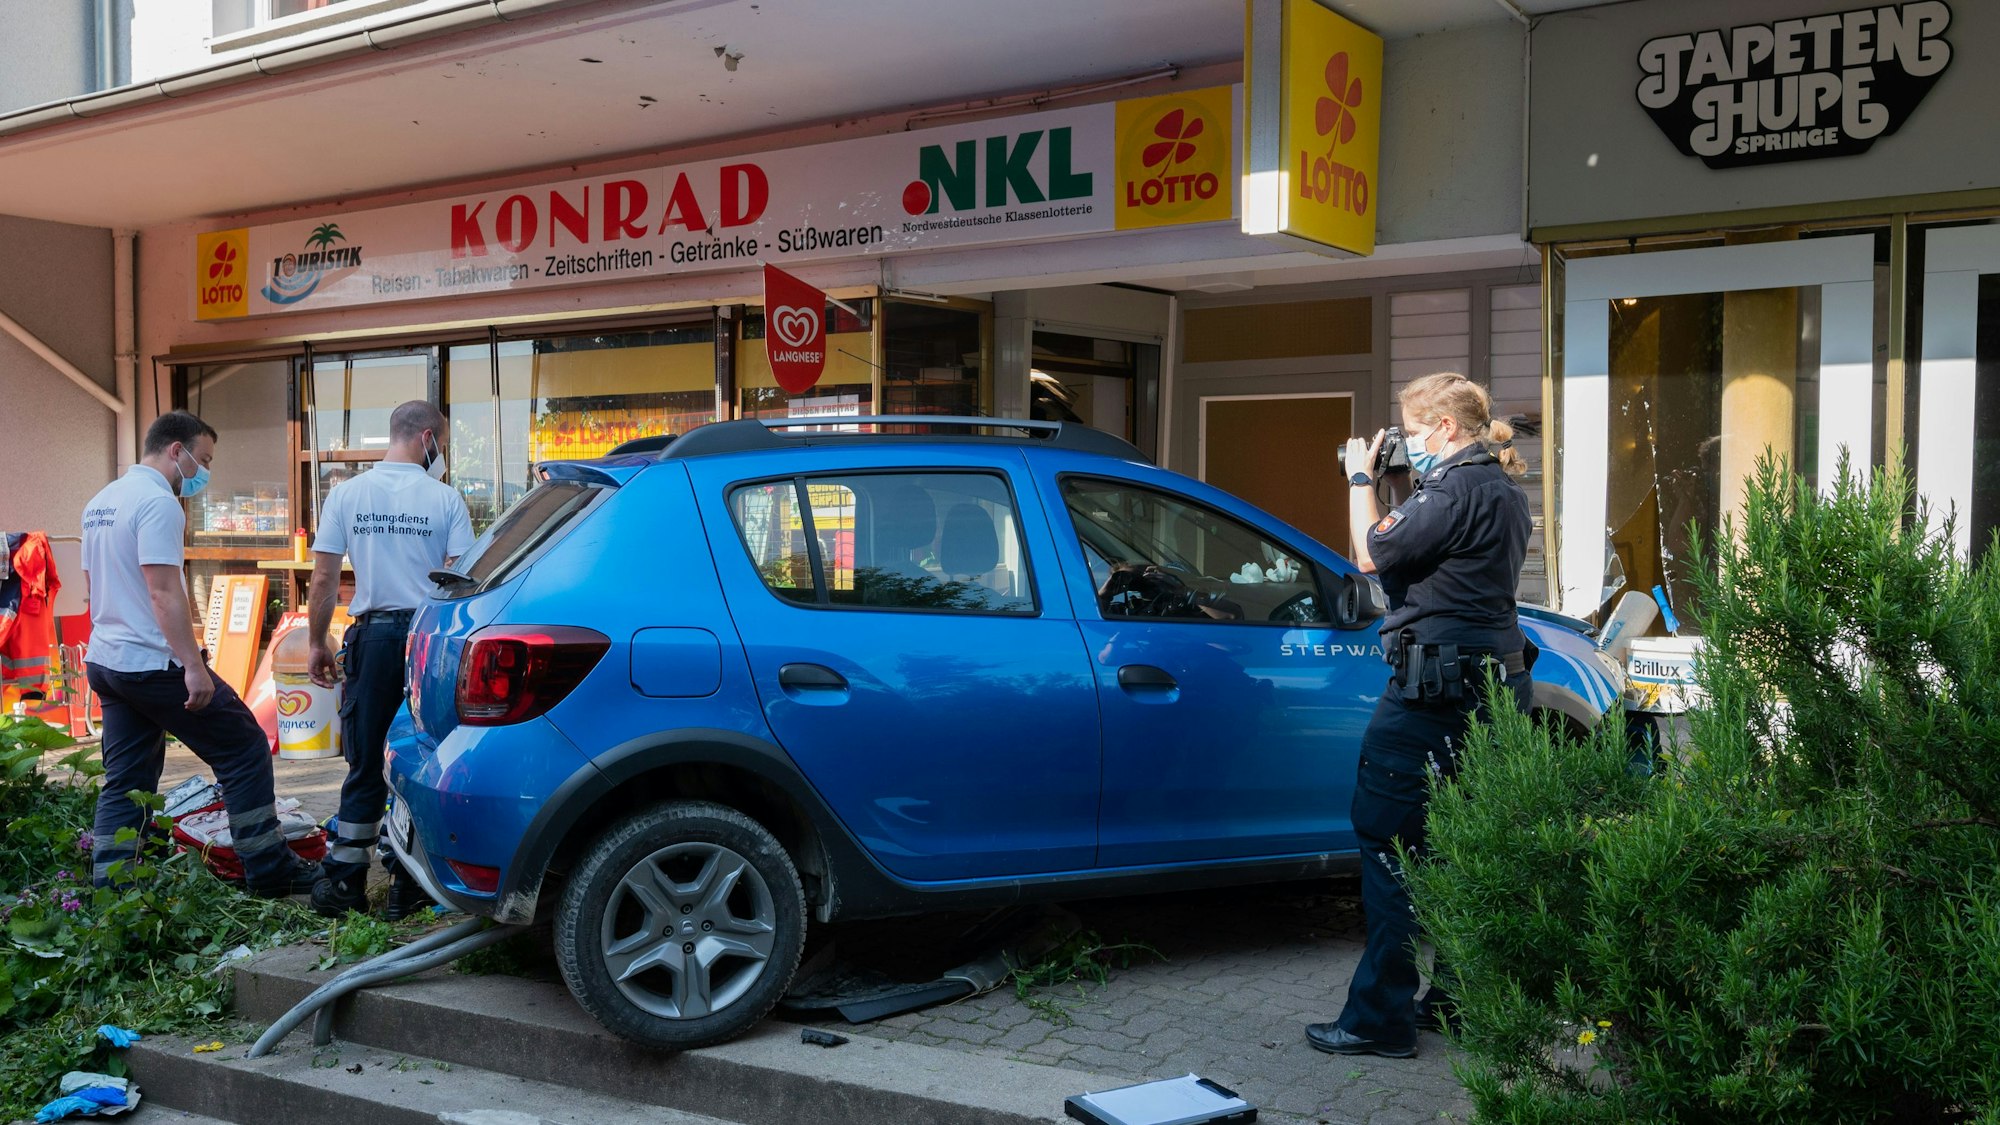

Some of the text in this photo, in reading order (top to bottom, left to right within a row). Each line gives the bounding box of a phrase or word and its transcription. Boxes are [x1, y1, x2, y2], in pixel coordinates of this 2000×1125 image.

[1637, 1, 1950, 108] TAPETEN
[1690, 66, 1889, 157] HUPE
[1735, 127, 1838, 154] SPRINGE
[919, 126, 1093, 215] NKL
[1301, 150, 1368, 217] LOTTO
[1127, 172, 1218, 208] LOTTO
[451, 163, 769, 259] KONRAD
[902, 203, 1092, 233] Nordwestdeutsche Klassenlotterie
[273, 246, 362, 277] TOURISTIK
[372, 273, 421, 294] Reisen
[435, 263, 529, 288] Tabakwaren
[545, 249, 653, 277] Zeitschriften
[670, 235, 758, 264] Getränke
[778, 224, 883, 253] Süßwaren
[202, 284, 243, 305] LOTTO
[353, 523, 433, 537] Region Hannover
[356, 513, 429, 525] Rettungsdienst
[1280, 644, 1382, 656] STEPWA
[1634, 660, 1680, 677] Brillux
[279, 719, 316, 734] angnese
